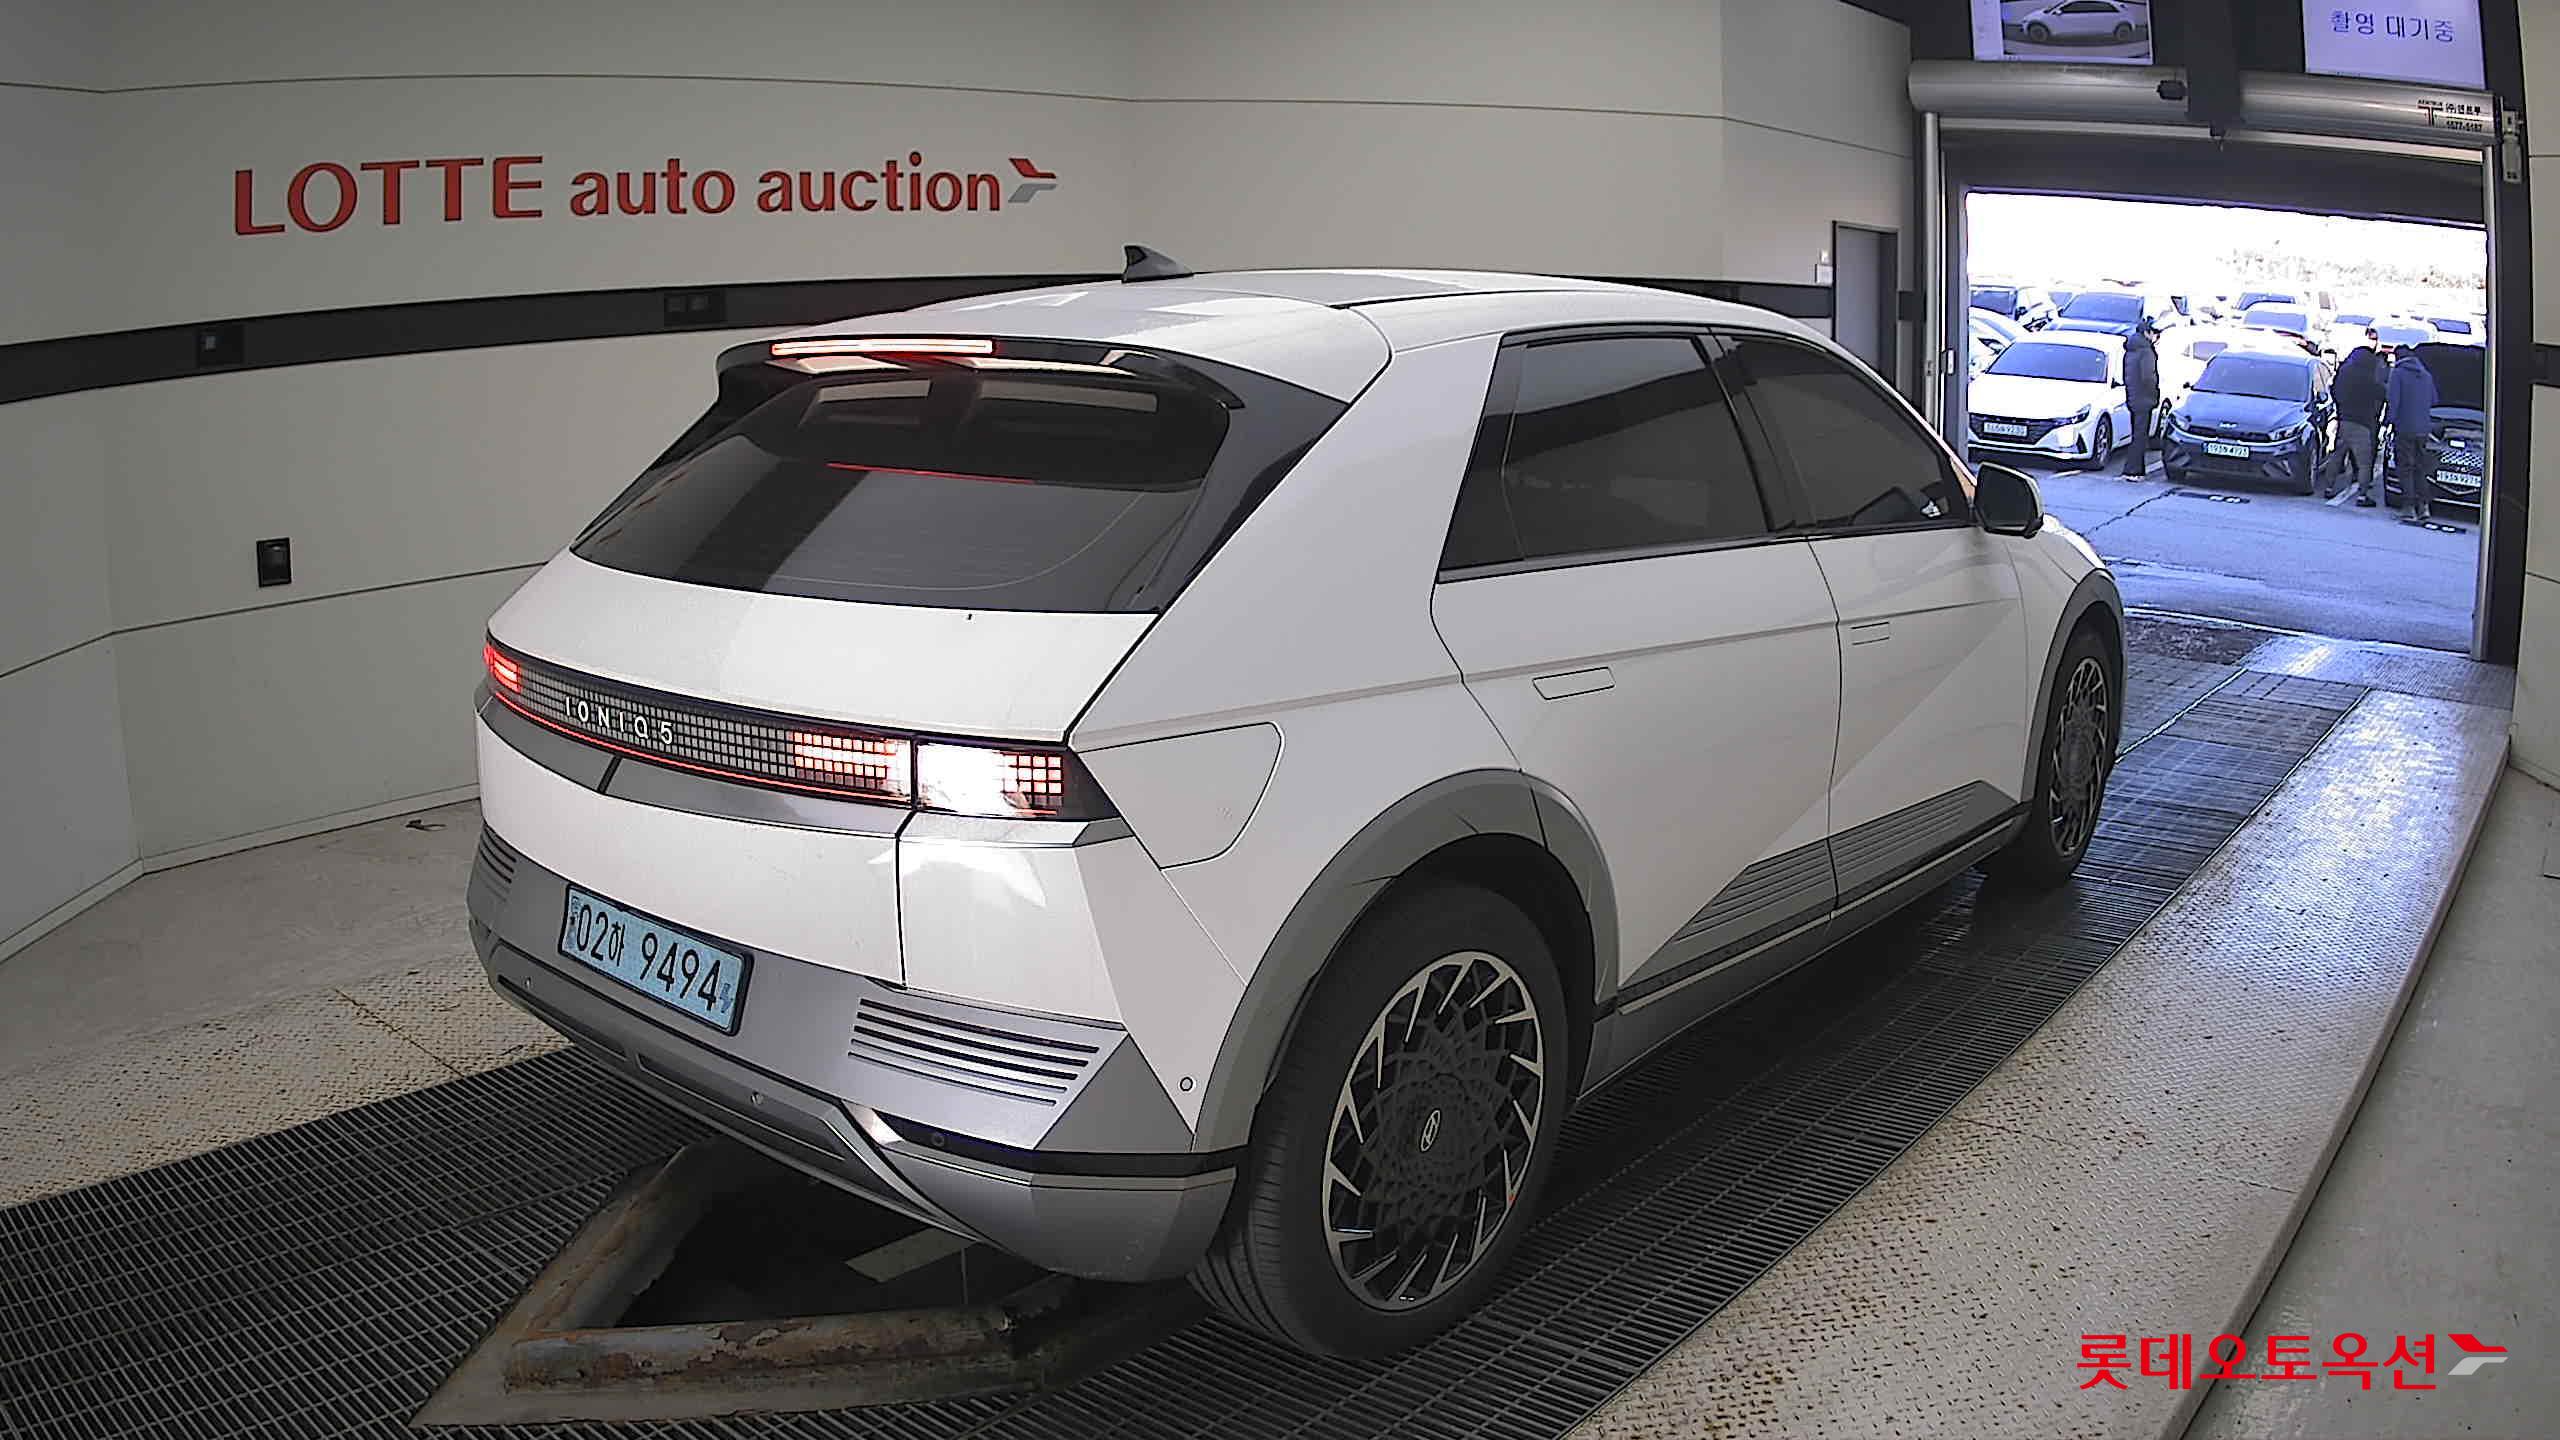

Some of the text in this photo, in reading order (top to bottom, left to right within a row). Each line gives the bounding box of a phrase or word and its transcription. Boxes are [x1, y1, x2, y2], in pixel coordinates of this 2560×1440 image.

[2331, 10, 2454, 43] 촬영 대기중
[234, 151, 1001, 235] LOTTE auto auction
[565, 696, 673, 745] IONIQ 5
[576, 903, 722, 1012] 02하 9494
